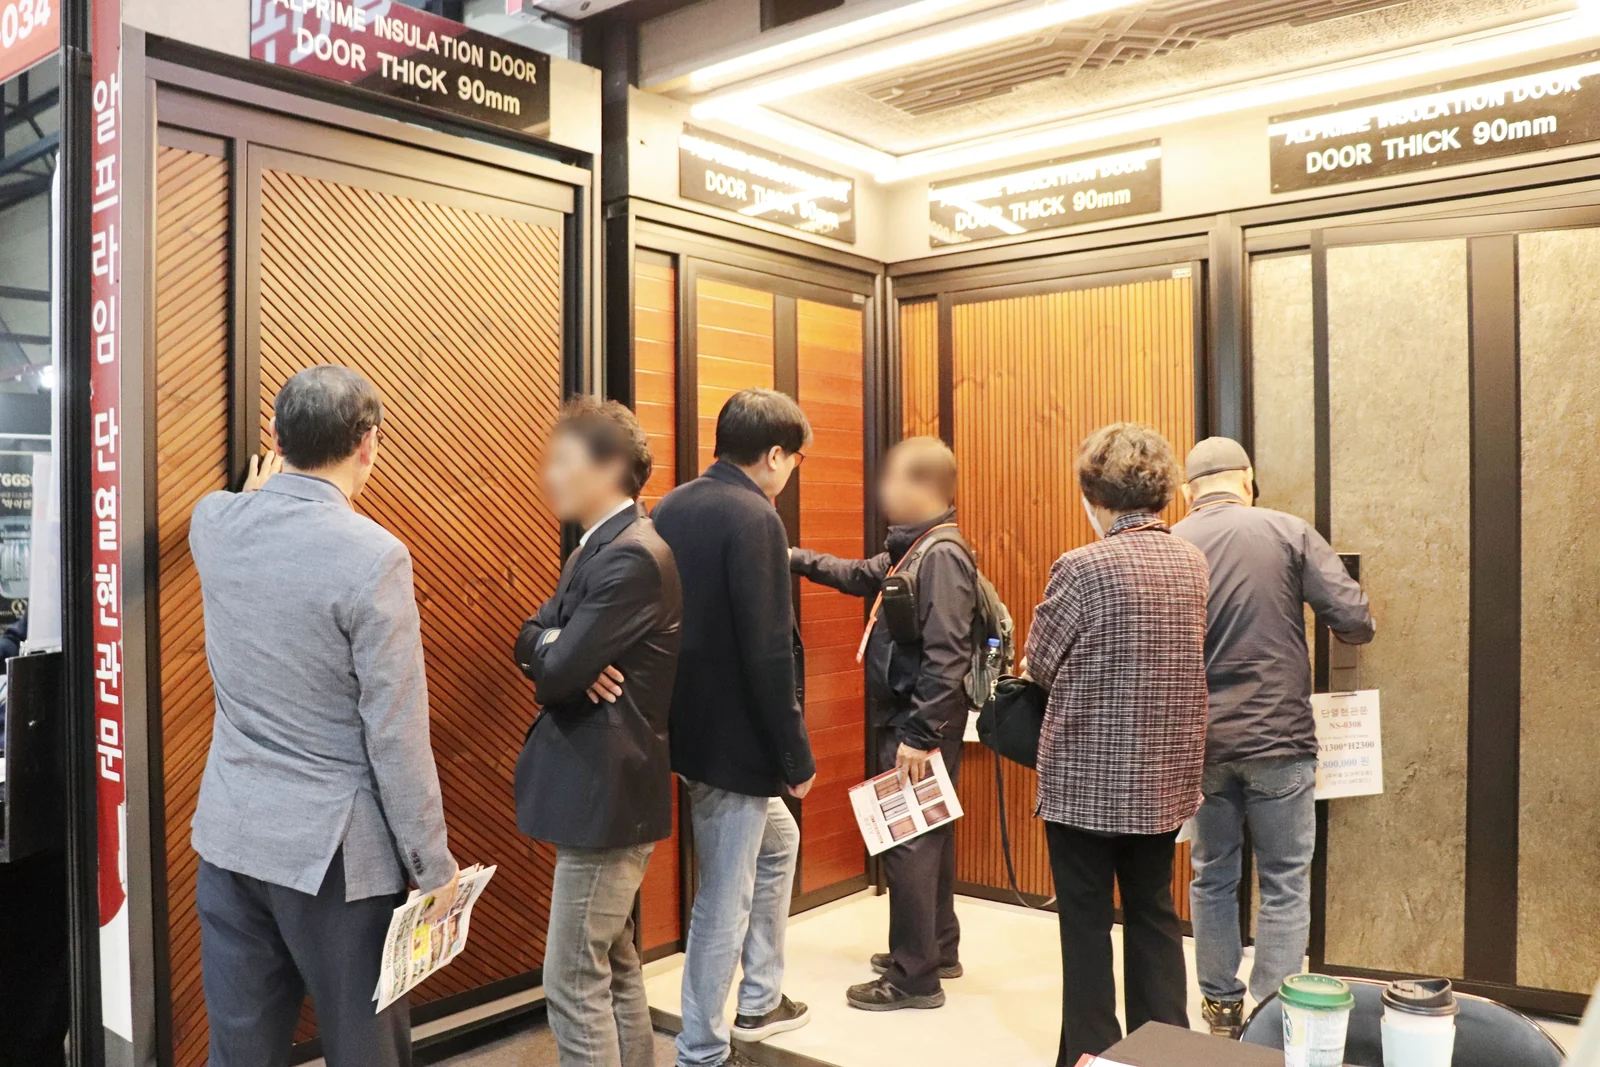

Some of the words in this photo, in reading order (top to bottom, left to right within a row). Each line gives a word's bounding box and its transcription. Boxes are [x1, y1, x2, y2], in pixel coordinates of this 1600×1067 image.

[296, 27, 367, 72] DOOR
[376, 51, 448, 95] THICK
[458, 75, 520, 115] 90mm
[374, 14, 483, 68] INSULATION
[489, 54, 537, 84] DOOR
[1305, 142, 1372, 174] DOOR
[1380, 126, 1461, 160] THICK
[1472, 114, 1557, 145] 90mm
[93, 72, 120, 364] 알프라임
[705, 170, 747, 201] DOOR
[1008, 194, 1066, 222] THICK
[1072, 188, 1131, 212] 90mm
[94, 407, 122, 782] 단열현관문
